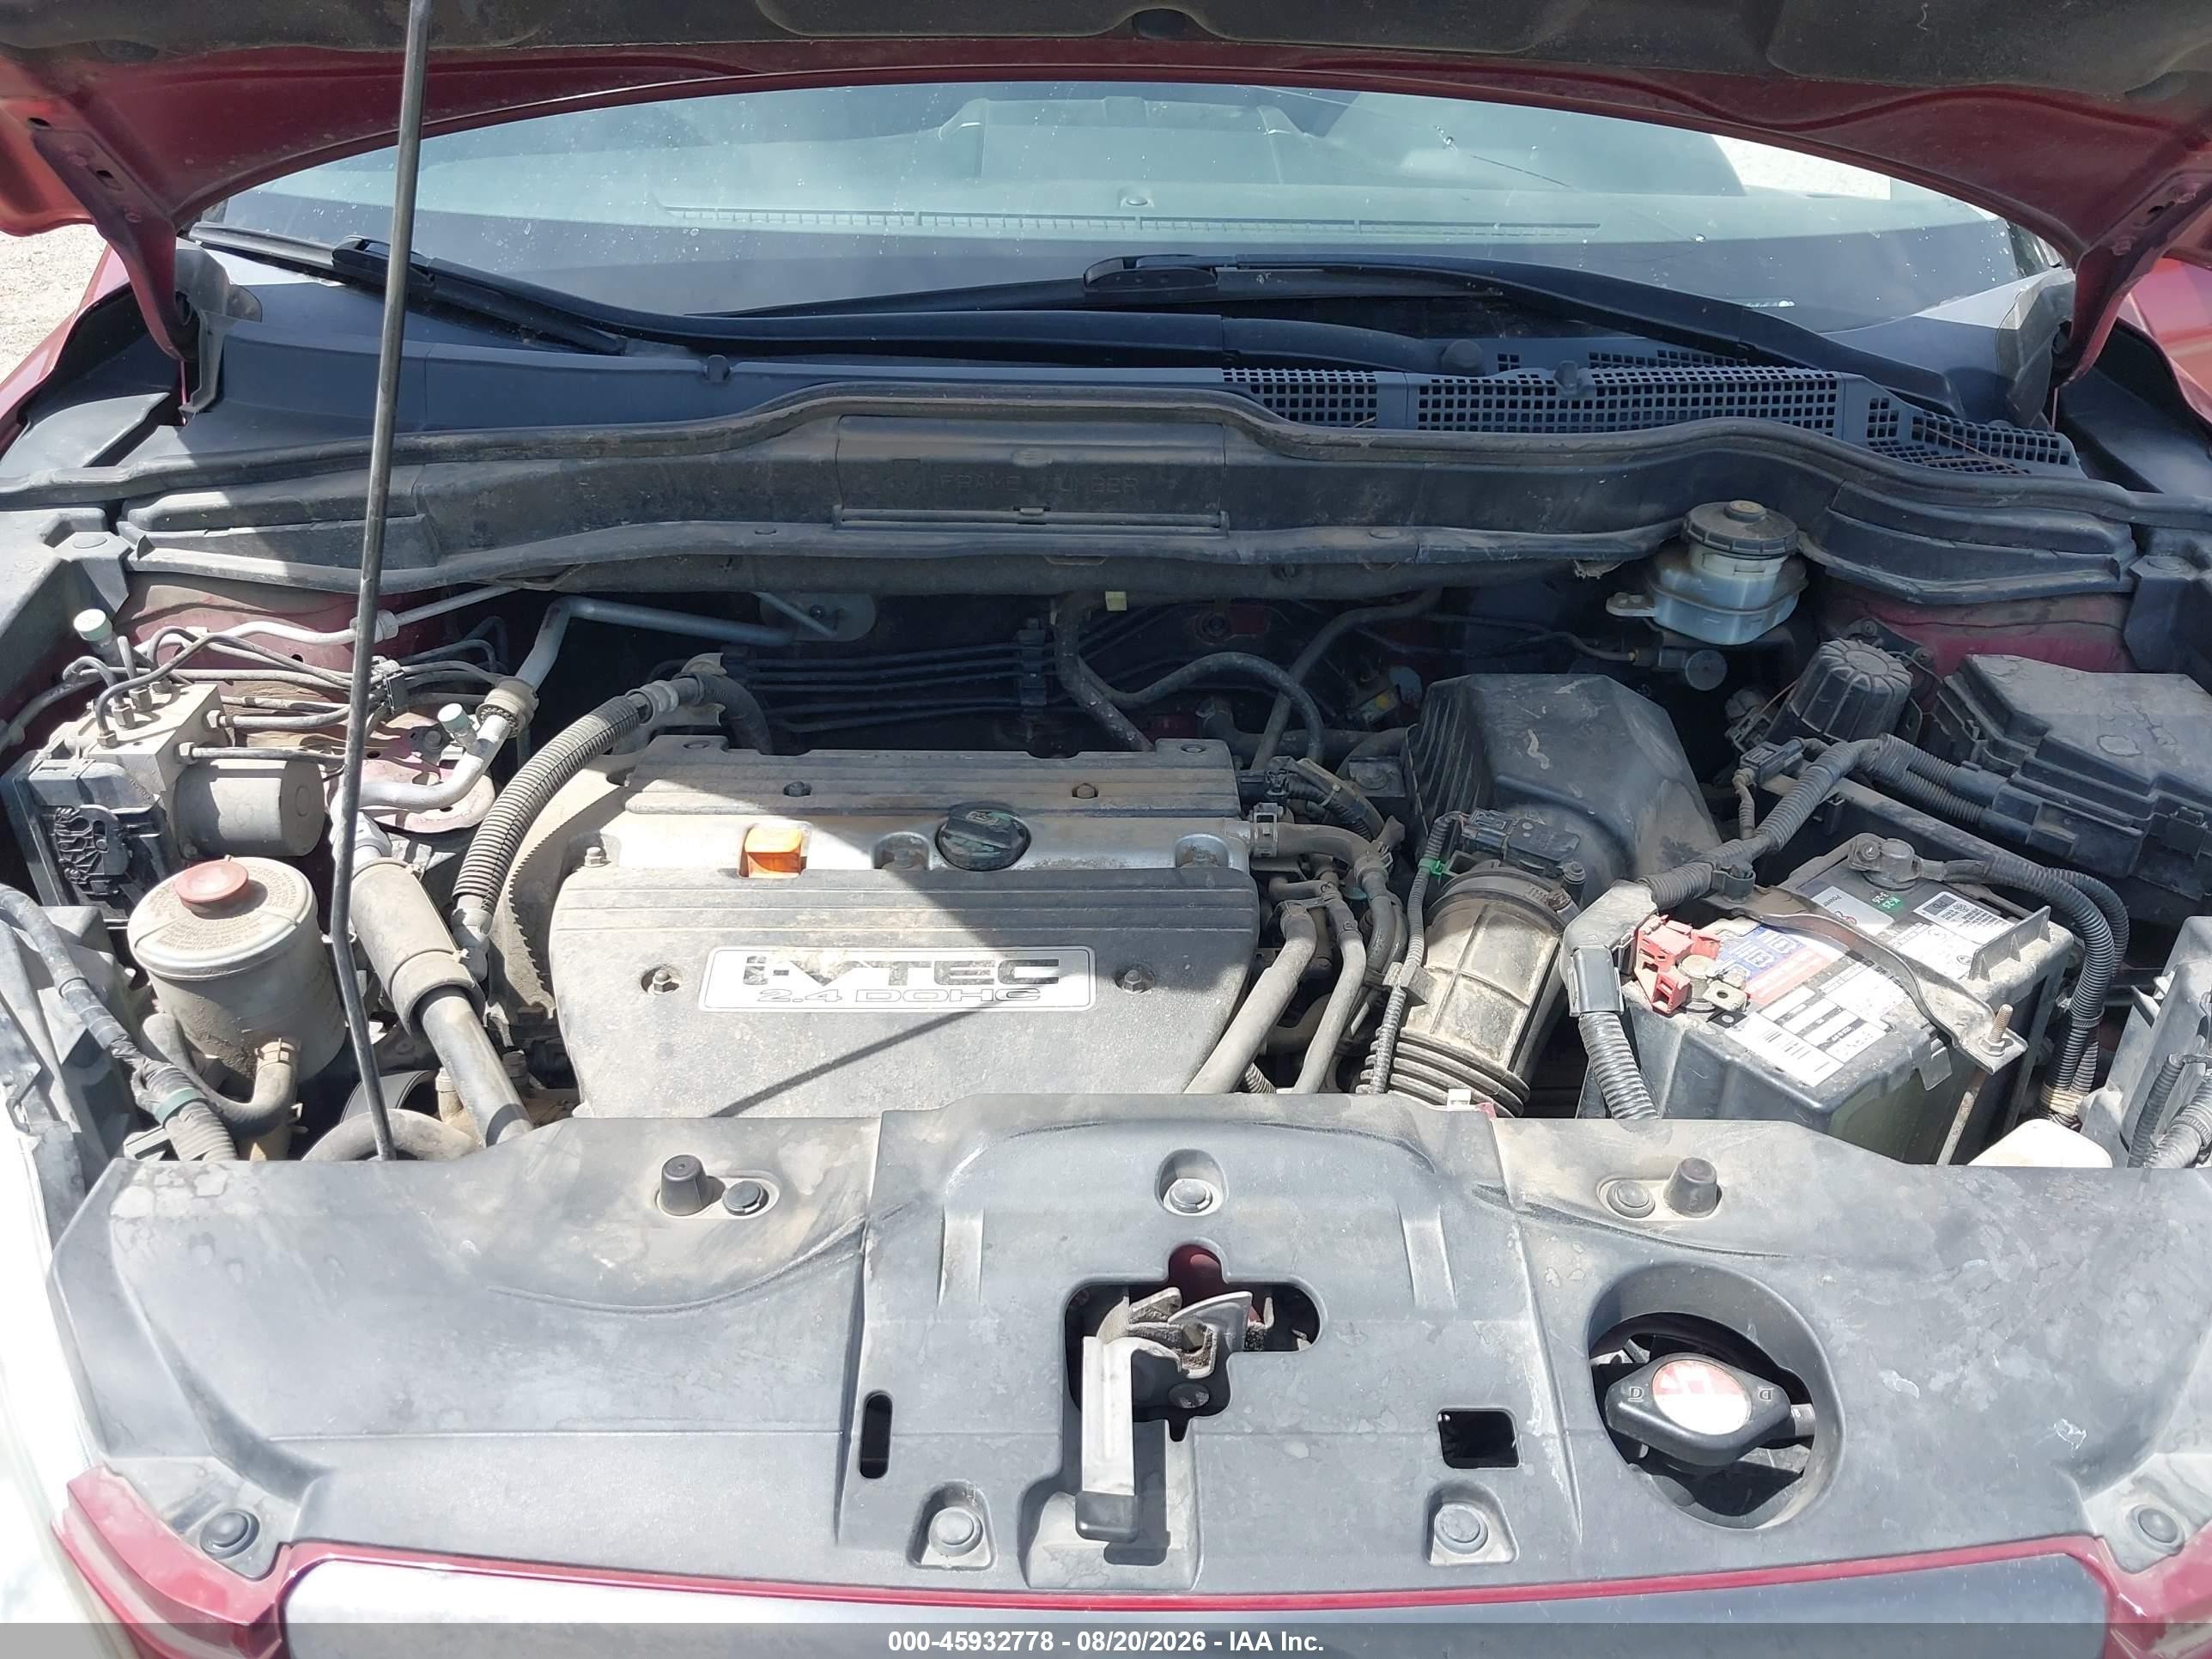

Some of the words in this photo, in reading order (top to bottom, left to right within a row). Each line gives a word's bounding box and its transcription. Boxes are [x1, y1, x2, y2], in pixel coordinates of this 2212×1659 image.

[939, 474, 1022, 492] FRAME
[743, 955, 1059, 987] i-VTEC
[757, 988, 842, 1002] 2.4
[855, 988, 1041, 1003] DOHC
